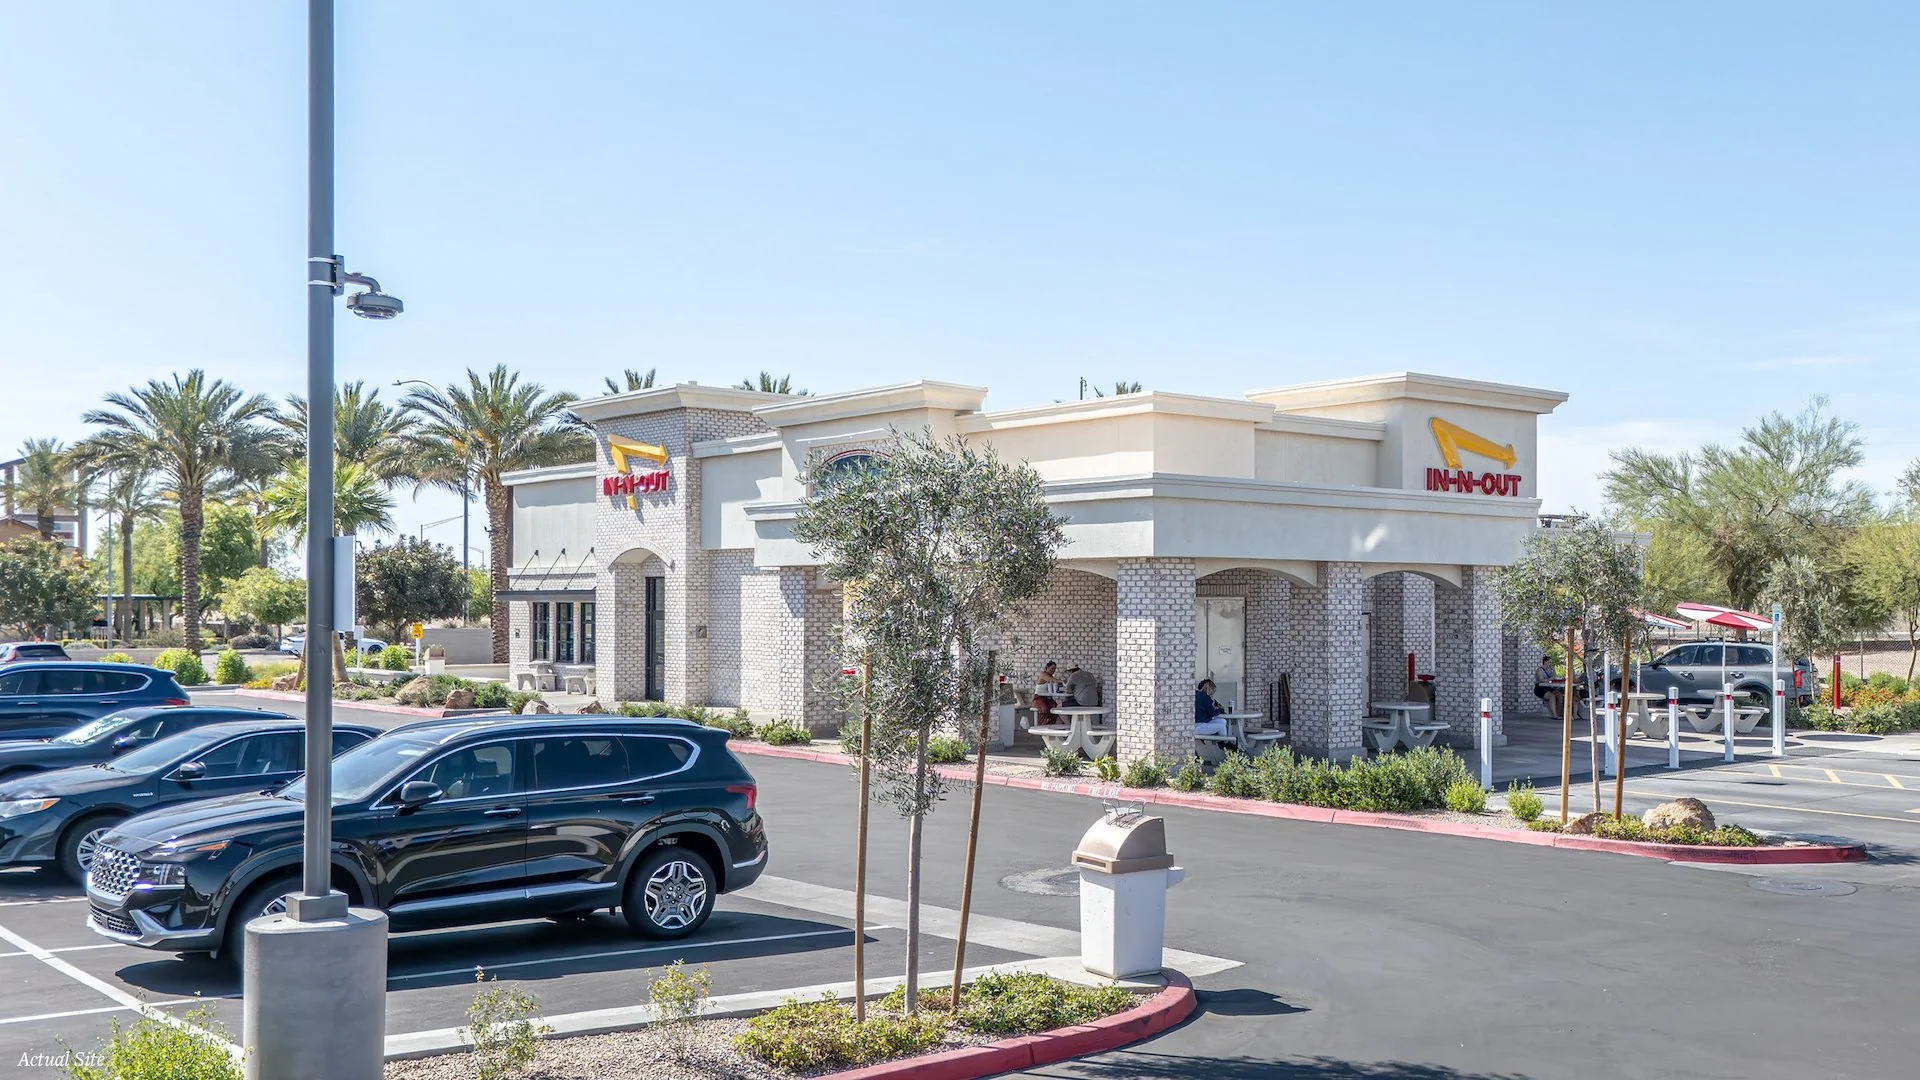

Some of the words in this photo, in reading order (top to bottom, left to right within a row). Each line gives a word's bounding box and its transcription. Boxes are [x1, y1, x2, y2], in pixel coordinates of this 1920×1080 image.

[603, 470, 670, 496] IN-N-OUT
[1426, 468, 1522, 497] IN-N-OUT
[1051, 783, 1076, 794] PARKING
[1087, 785, 1102, 796] FIRE
[1104, 787, 1120, 798] LANE
